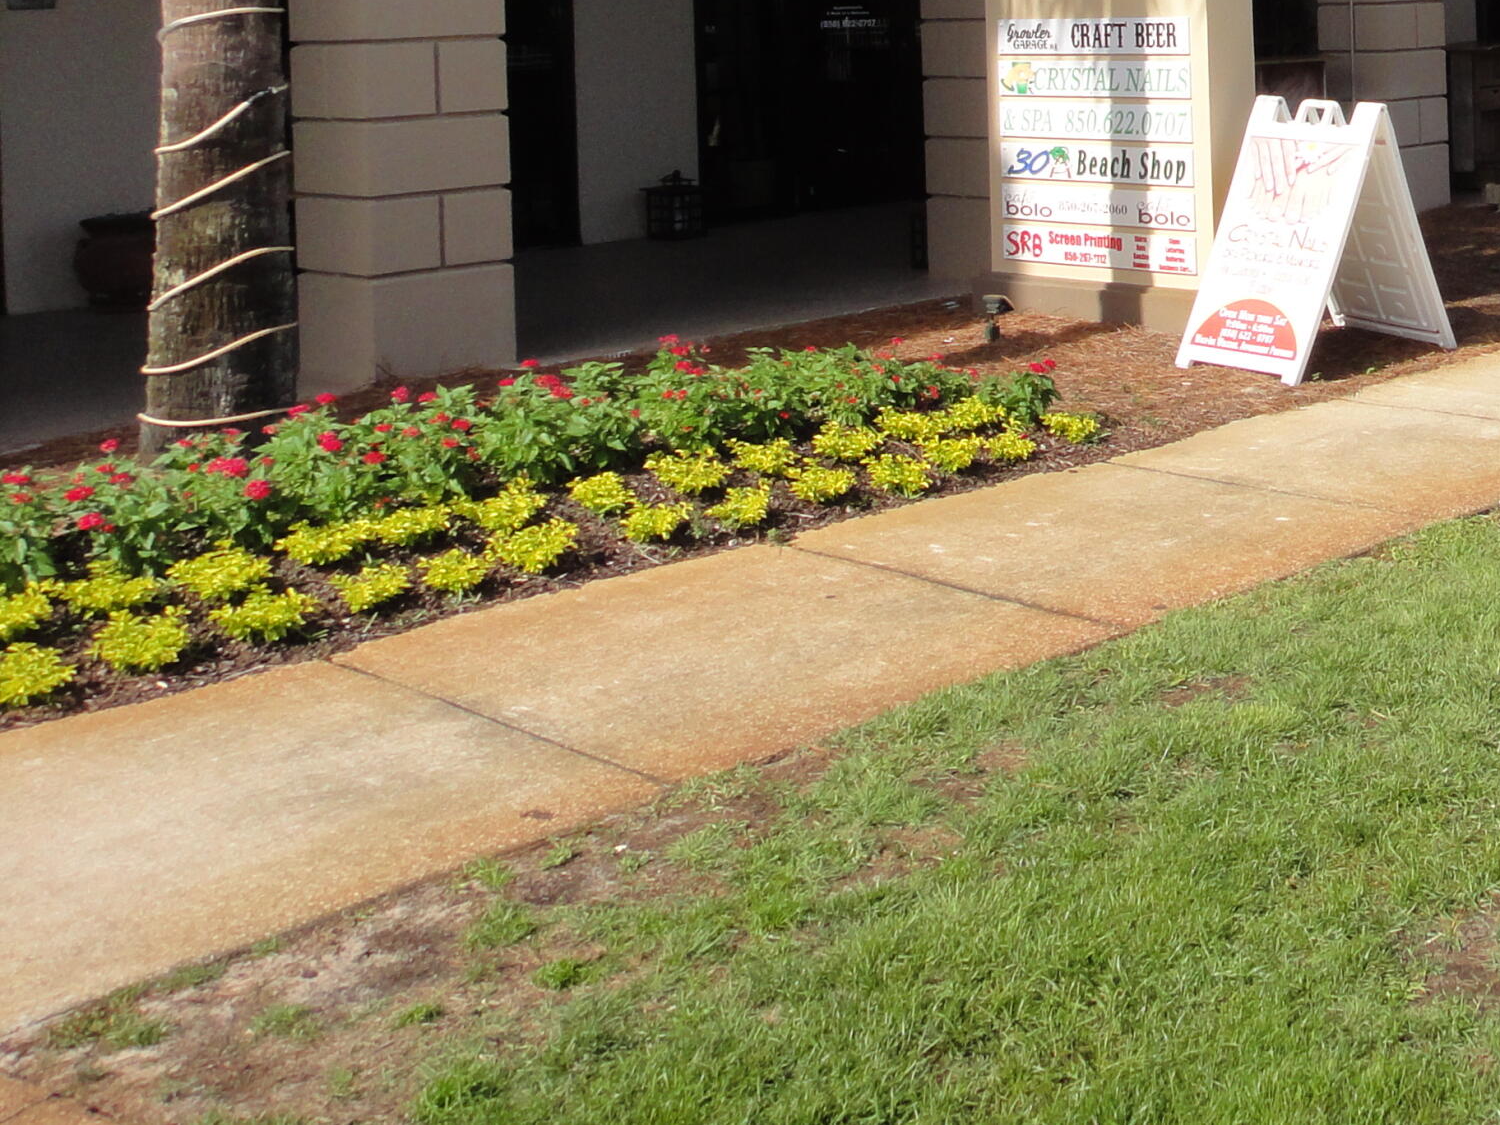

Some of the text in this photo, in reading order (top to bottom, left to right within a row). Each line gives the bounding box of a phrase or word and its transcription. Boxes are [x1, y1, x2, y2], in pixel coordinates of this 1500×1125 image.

[1007, 23, 1052, 43] Growler
[1013, 39, 1049, 51] GARAGE
[1070, 22, 1177, 49] CRAFT BEER
[1034, 67, 1189, 93] CRYSTAL NAILS
[1004, 108, 1188, 136] & SPA 850.622.0707
[1076, 149, 1131, 179] Beach
[1138, 150, 1187, 185] Shop
[1006, 201, 1053, 217] bolo
[1138, 208, 1191, 226] bolo
[1006, 230, 1043, 258] SRB
[1048, 231, 1081, 247] Screen
[1084, 233, 1123, 252] Printing
